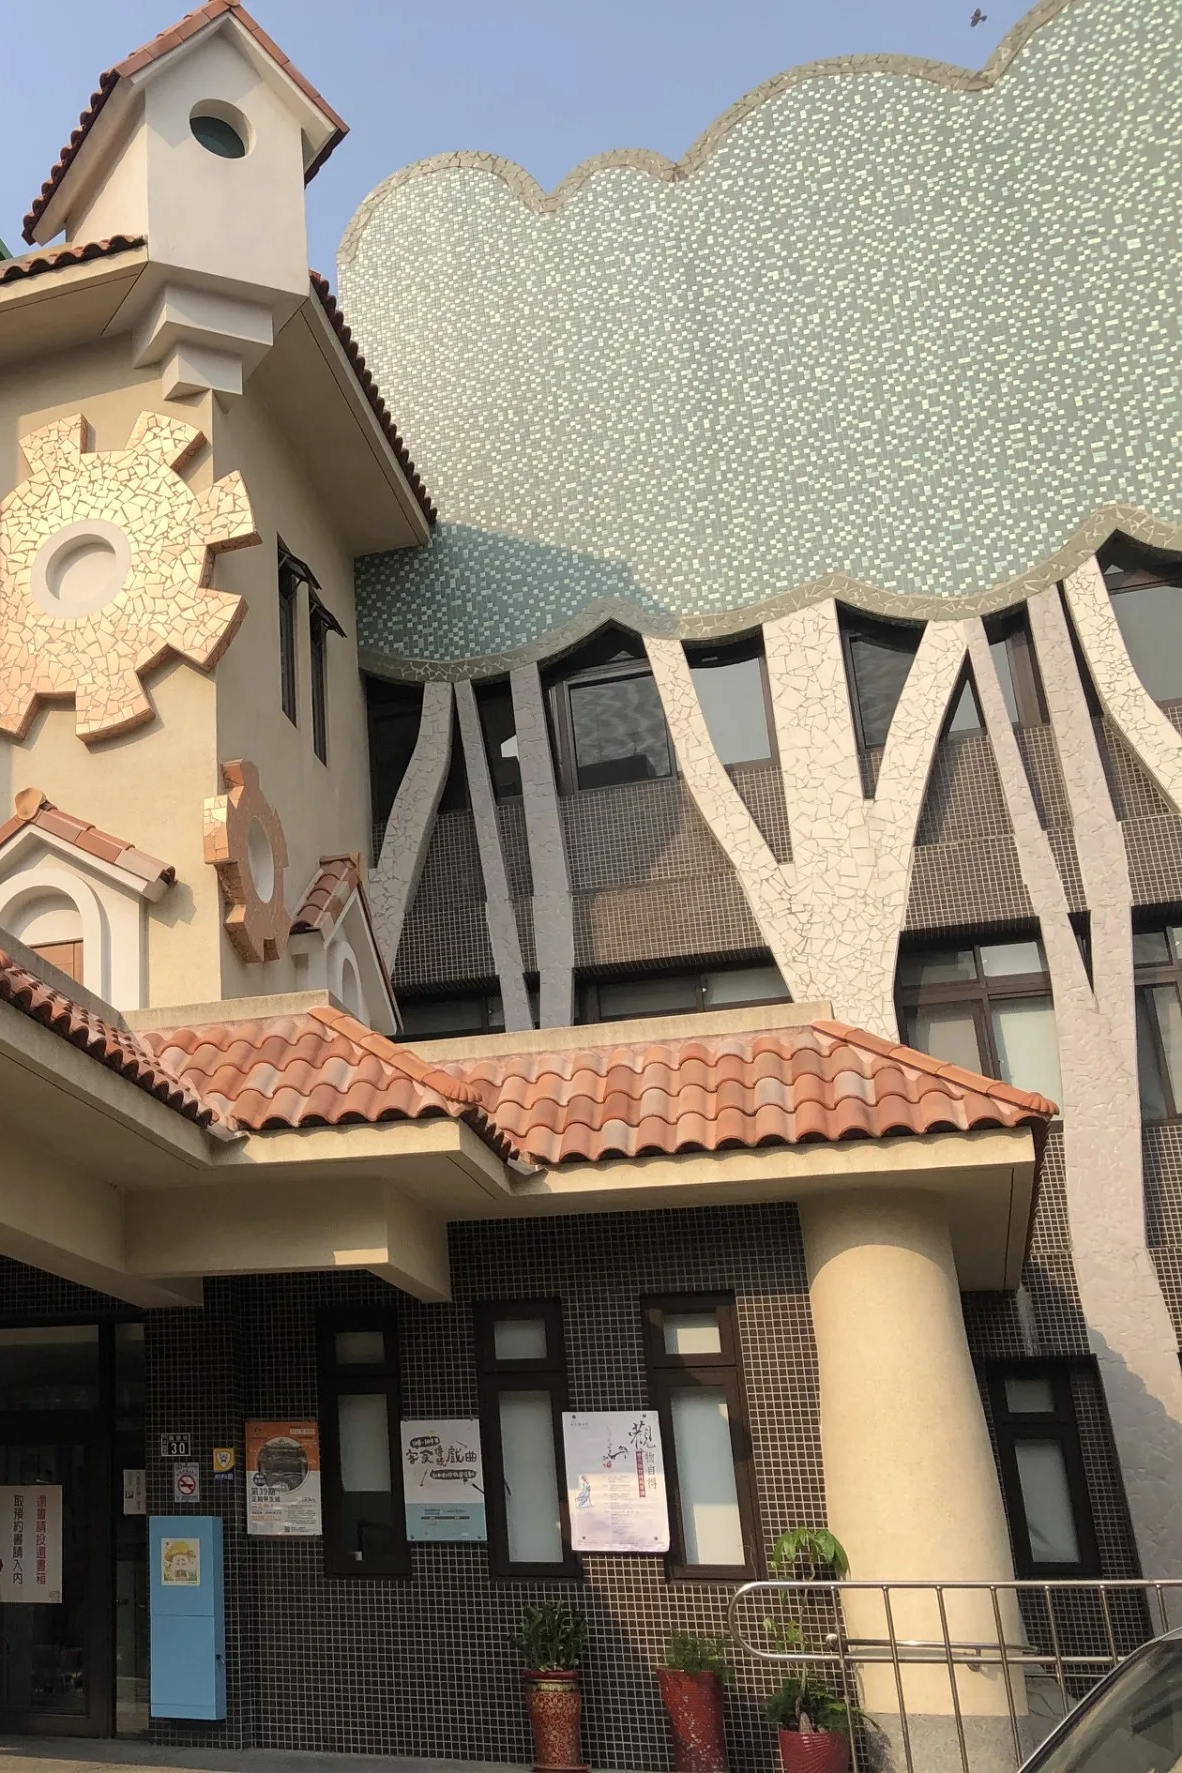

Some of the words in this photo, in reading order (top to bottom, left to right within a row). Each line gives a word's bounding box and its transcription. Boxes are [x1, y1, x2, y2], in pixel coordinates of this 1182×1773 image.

[171, 1442, 186, 1454] 30
[12, 1494, 24, 1585] 取預約書請入內
